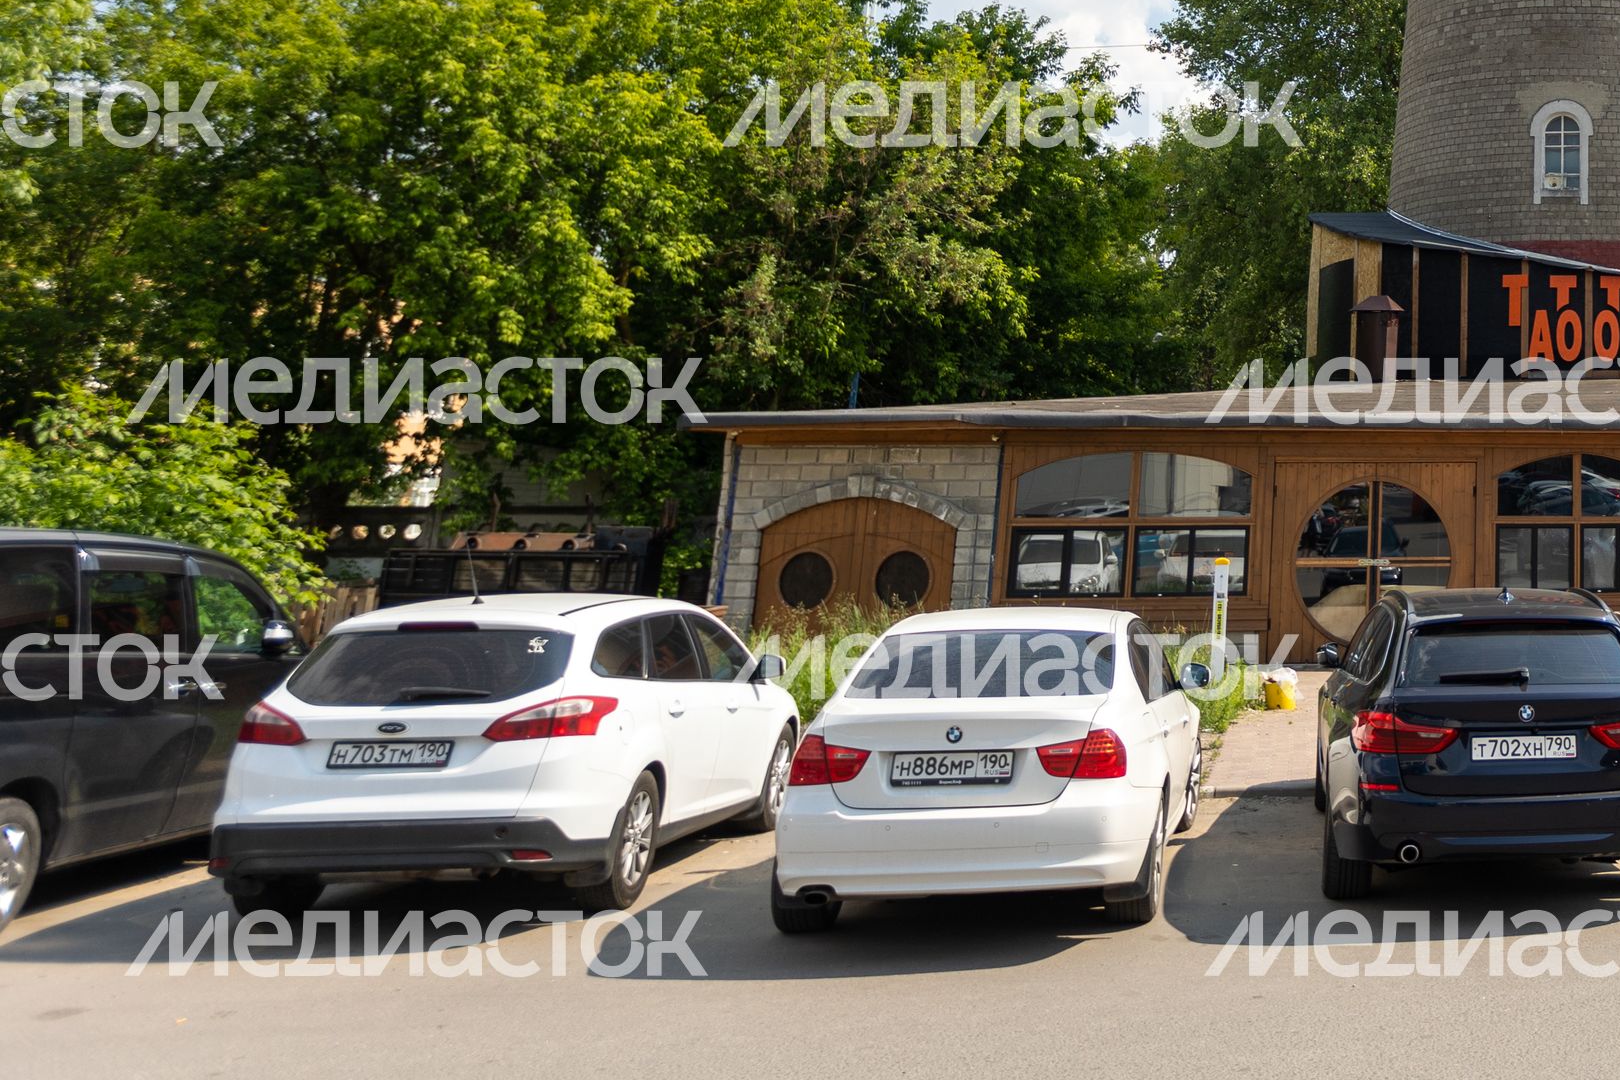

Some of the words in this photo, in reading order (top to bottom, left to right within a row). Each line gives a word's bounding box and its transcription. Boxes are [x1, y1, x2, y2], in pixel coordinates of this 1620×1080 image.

[418, 743, 446, 757] 190
[1478, 739, 1543, 757] Т702ХН
[1546, 736, 1571, 751] 790
[899, 756, 974, 776] Н886МР
[980, 754, 1007, 769] 190
